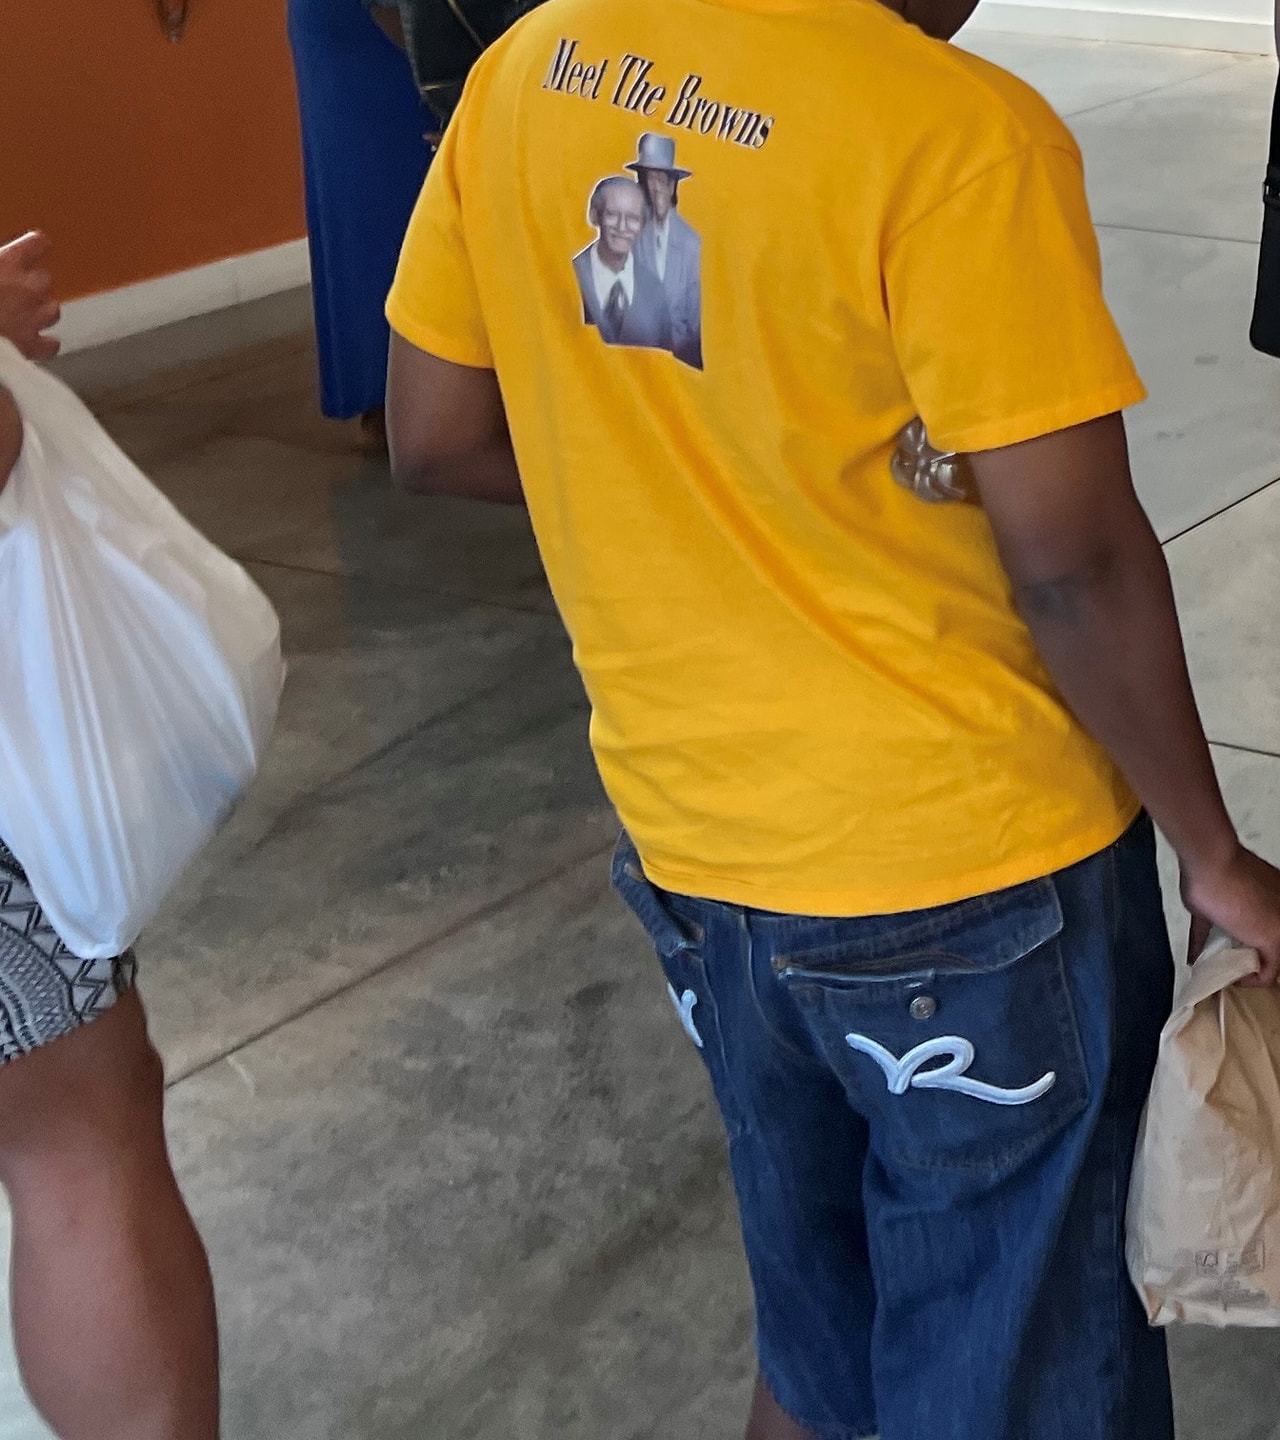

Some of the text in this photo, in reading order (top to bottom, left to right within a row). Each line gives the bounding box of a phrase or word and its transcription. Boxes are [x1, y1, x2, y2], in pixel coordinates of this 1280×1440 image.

[542, 38, 776, 151] Meet The Browns
